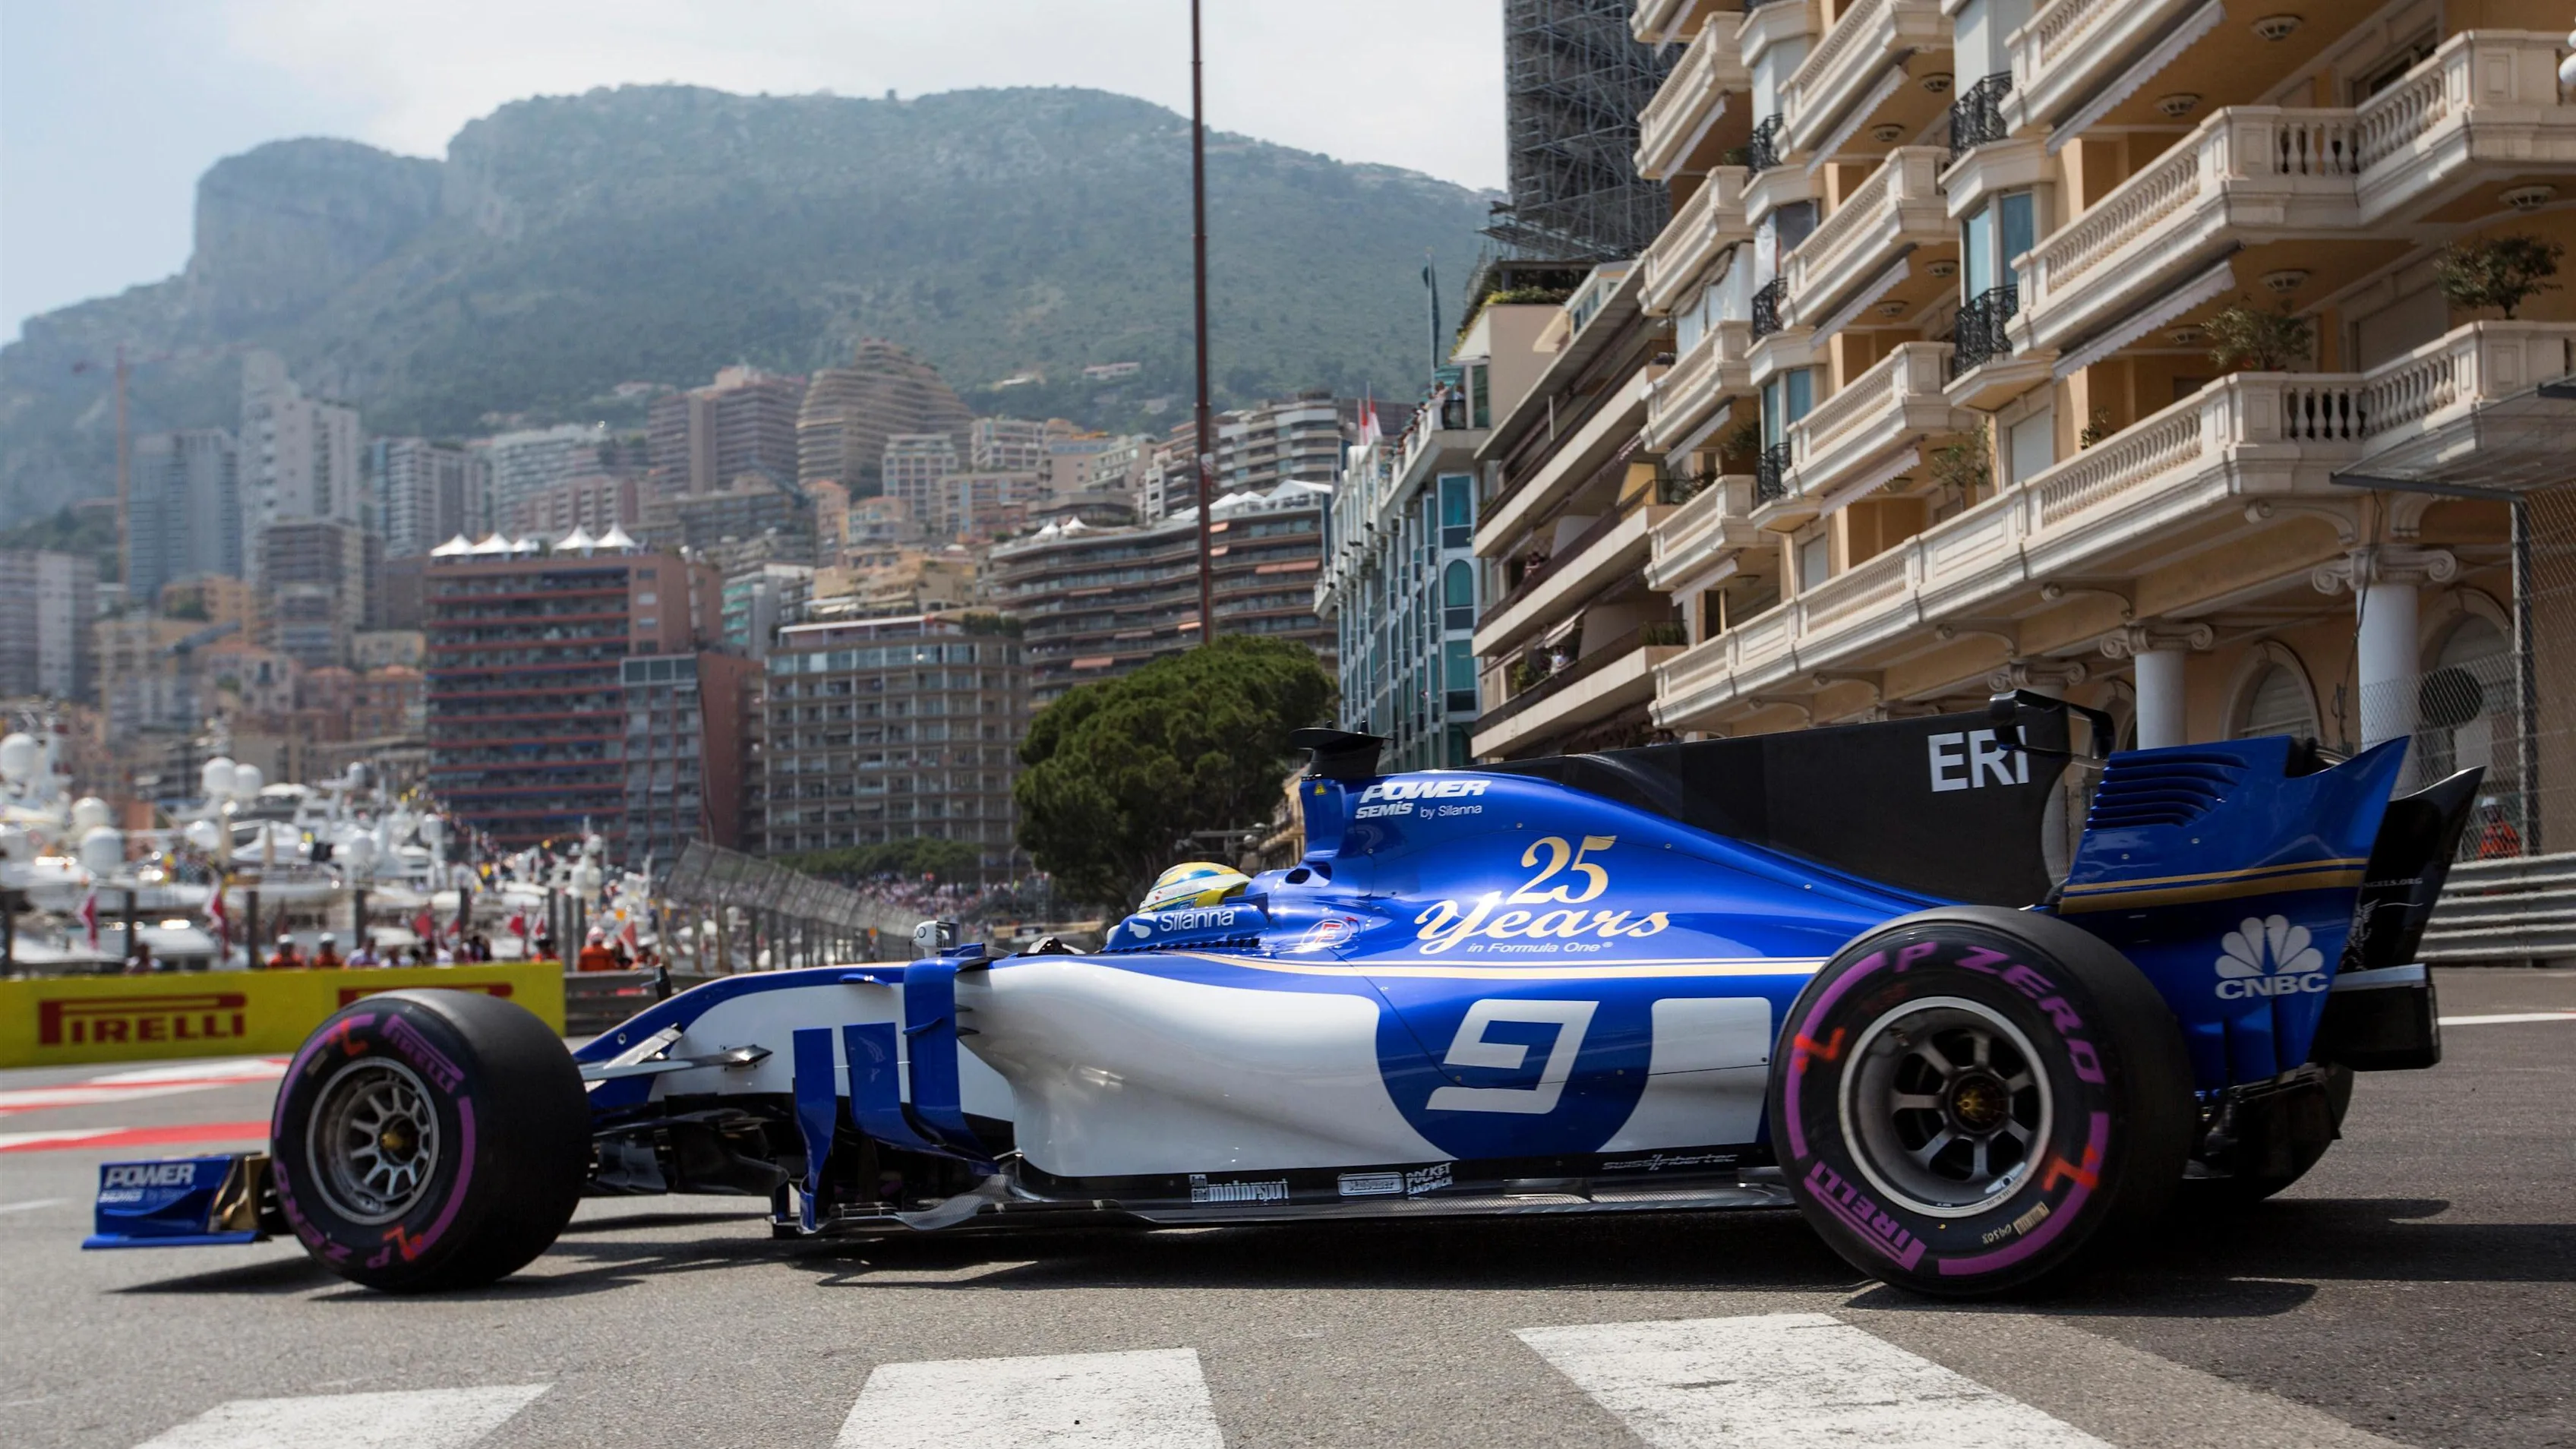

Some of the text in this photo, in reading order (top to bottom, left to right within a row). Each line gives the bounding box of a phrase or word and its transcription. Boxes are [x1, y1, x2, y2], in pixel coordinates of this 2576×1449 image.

[1359, 780, 1492, 803] POWER
[1419, 807, 1435, 819] by
[1438, 804, 1482, 817] Silanna
[1505, 835, 1618, 904] 25
[2362, 877, 2423, 887] NGELS.ORG
[1159, 910, 1235, 933] Silanna
[1414, 890, 1669, 955] Years
[1466, 942, 1485, 953] in
[1487, 942, 1558, 953] Formula
[2215, 973, 2329, 999] CNBC
[39, 992, 248, 1046] PIRELLI
[1893, 941, 1939, 973] P
[1954, 945, 2106, 1084] ZERO
[383, 1014, 465, 1094] PIRELLI
[1425, 999, 1600, 1114] 9
[104, 1163, 196, 1187] POWER
[1405, 1162, 1452, 1187] POCKET
[1406, 1176, 1454, 1196] SANDWICH
[1208, 1177, 1289, 1204] motorsport
[273, 1162, 391, 1269] P ZERO
[1804, 1160, 1927, 1271] PIRELLI
